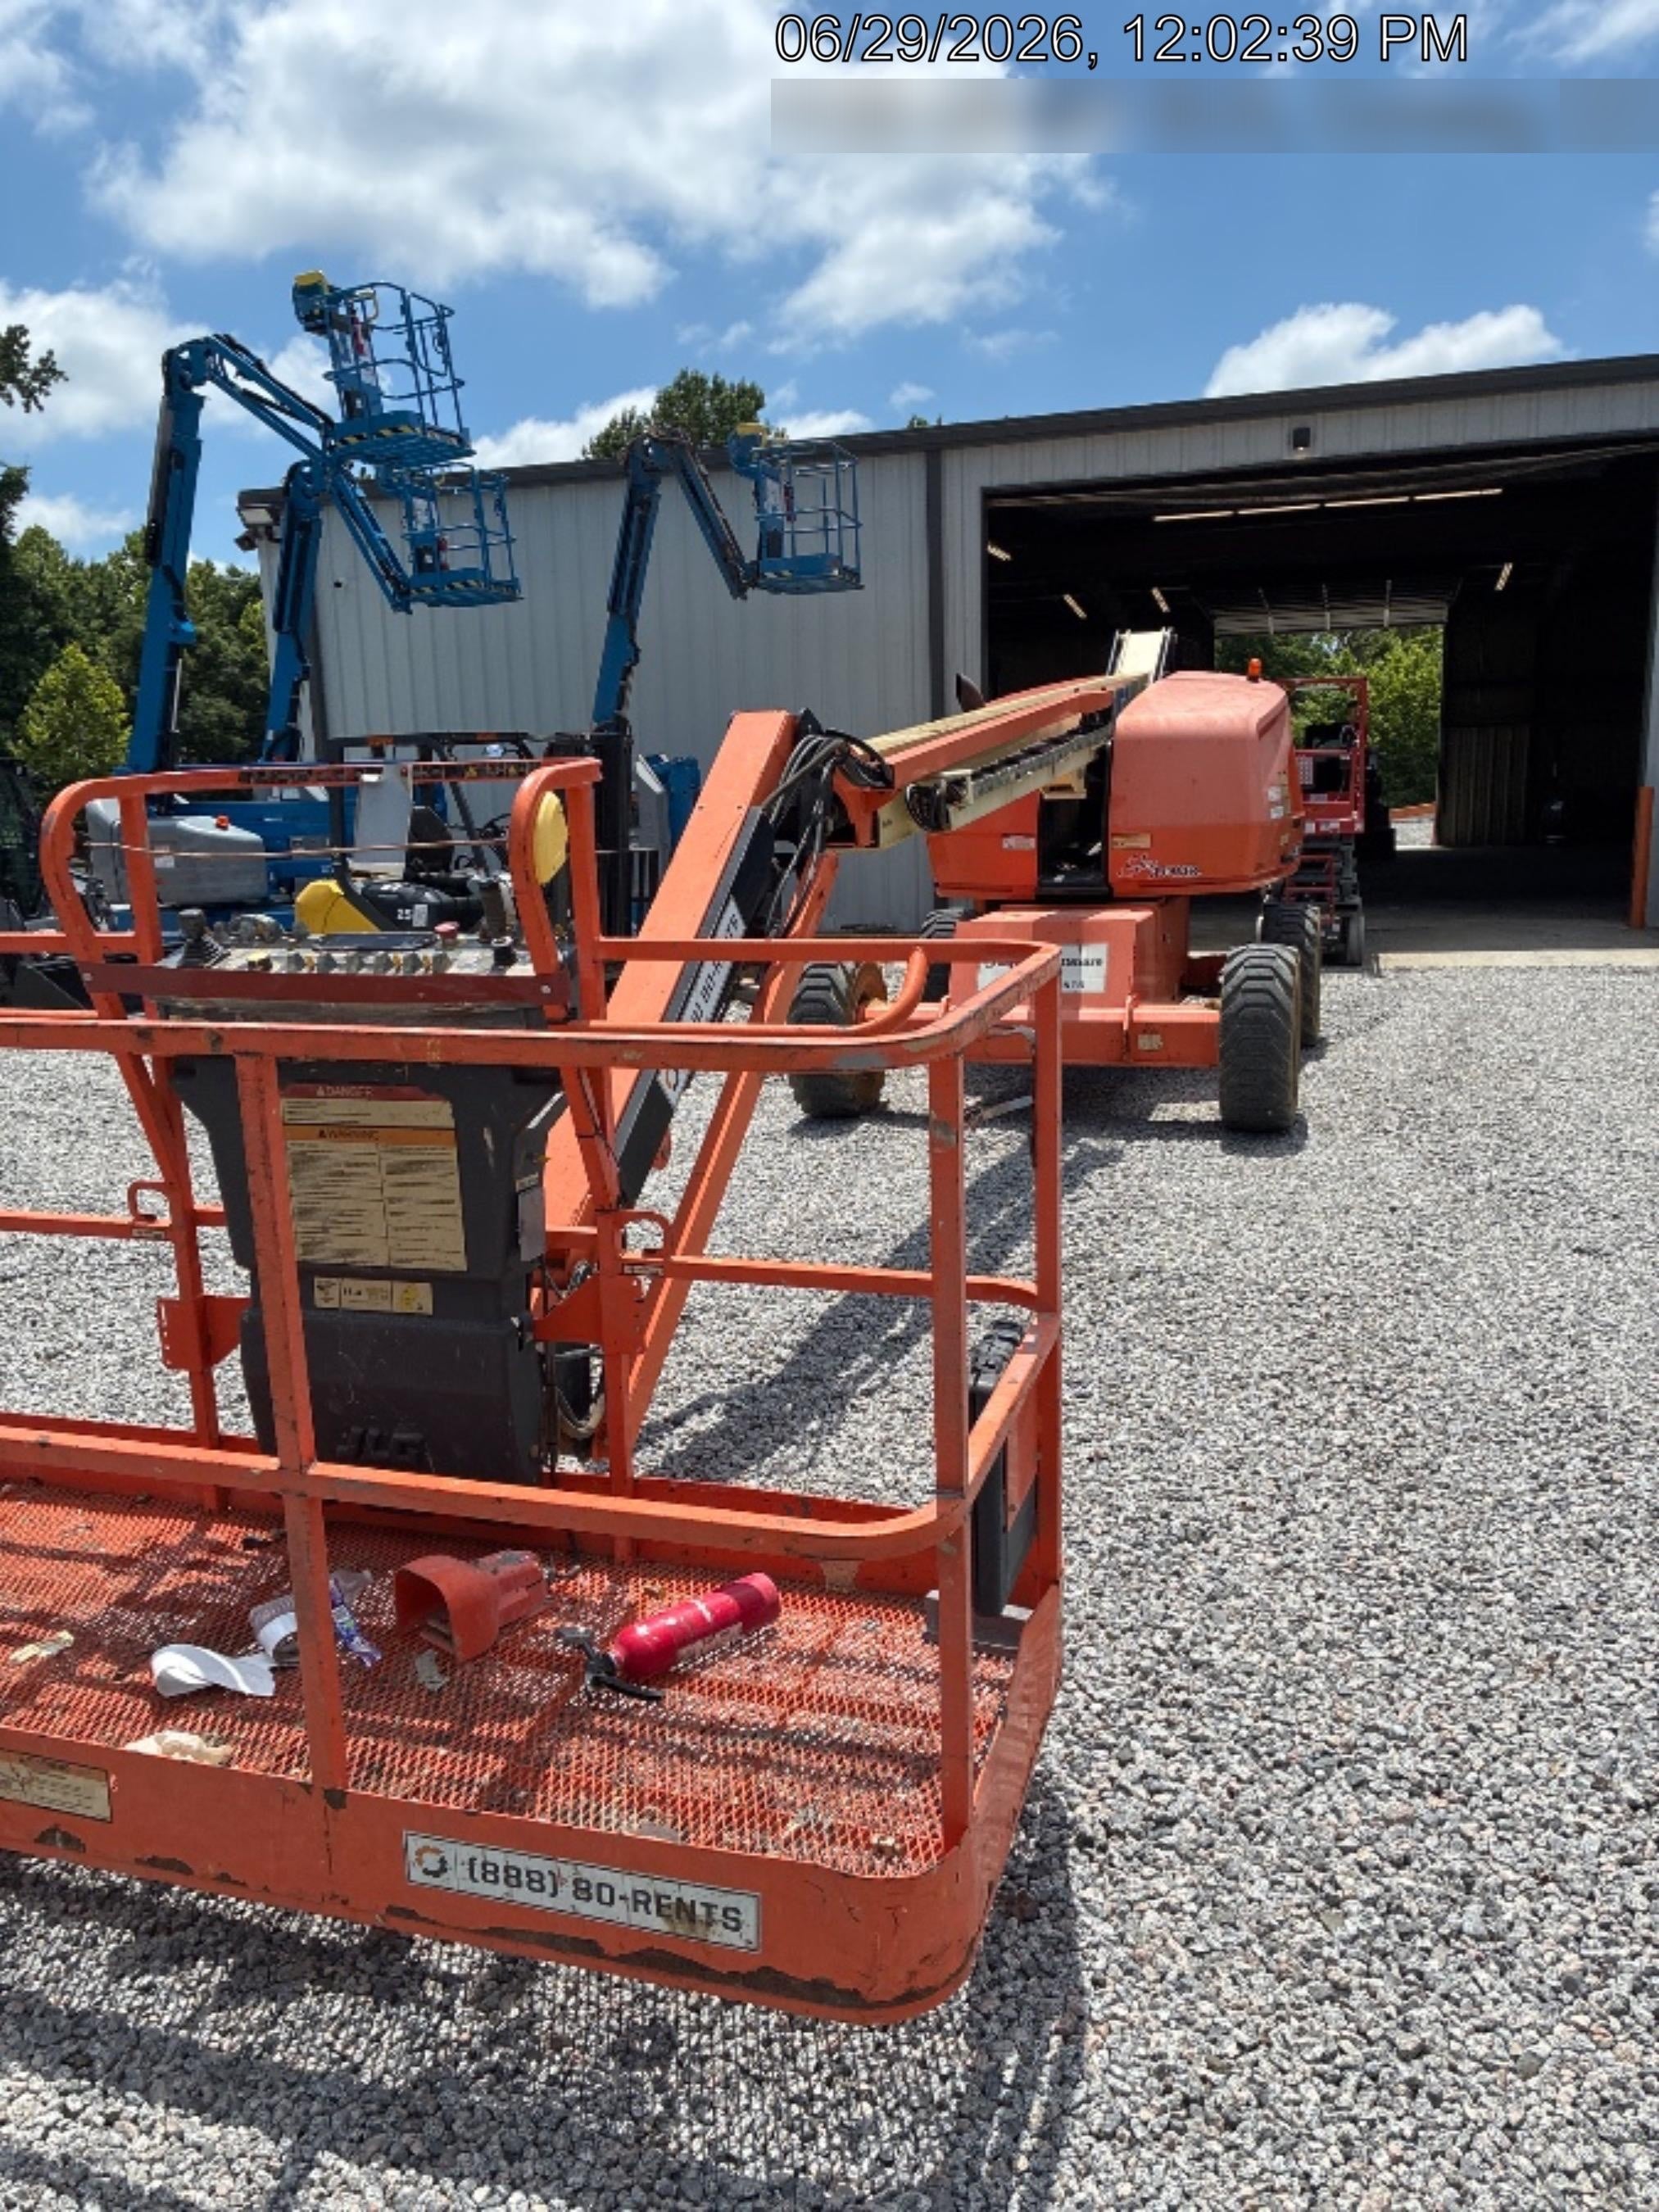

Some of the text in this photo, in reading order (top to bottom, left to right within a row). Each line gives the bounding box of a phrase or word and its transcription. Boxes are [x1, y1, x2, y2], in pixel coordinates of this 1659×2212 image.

[325, 1086, 374, 1097] DANGER
[468, 1856, 742, 1933] (888) 80-RENTS
